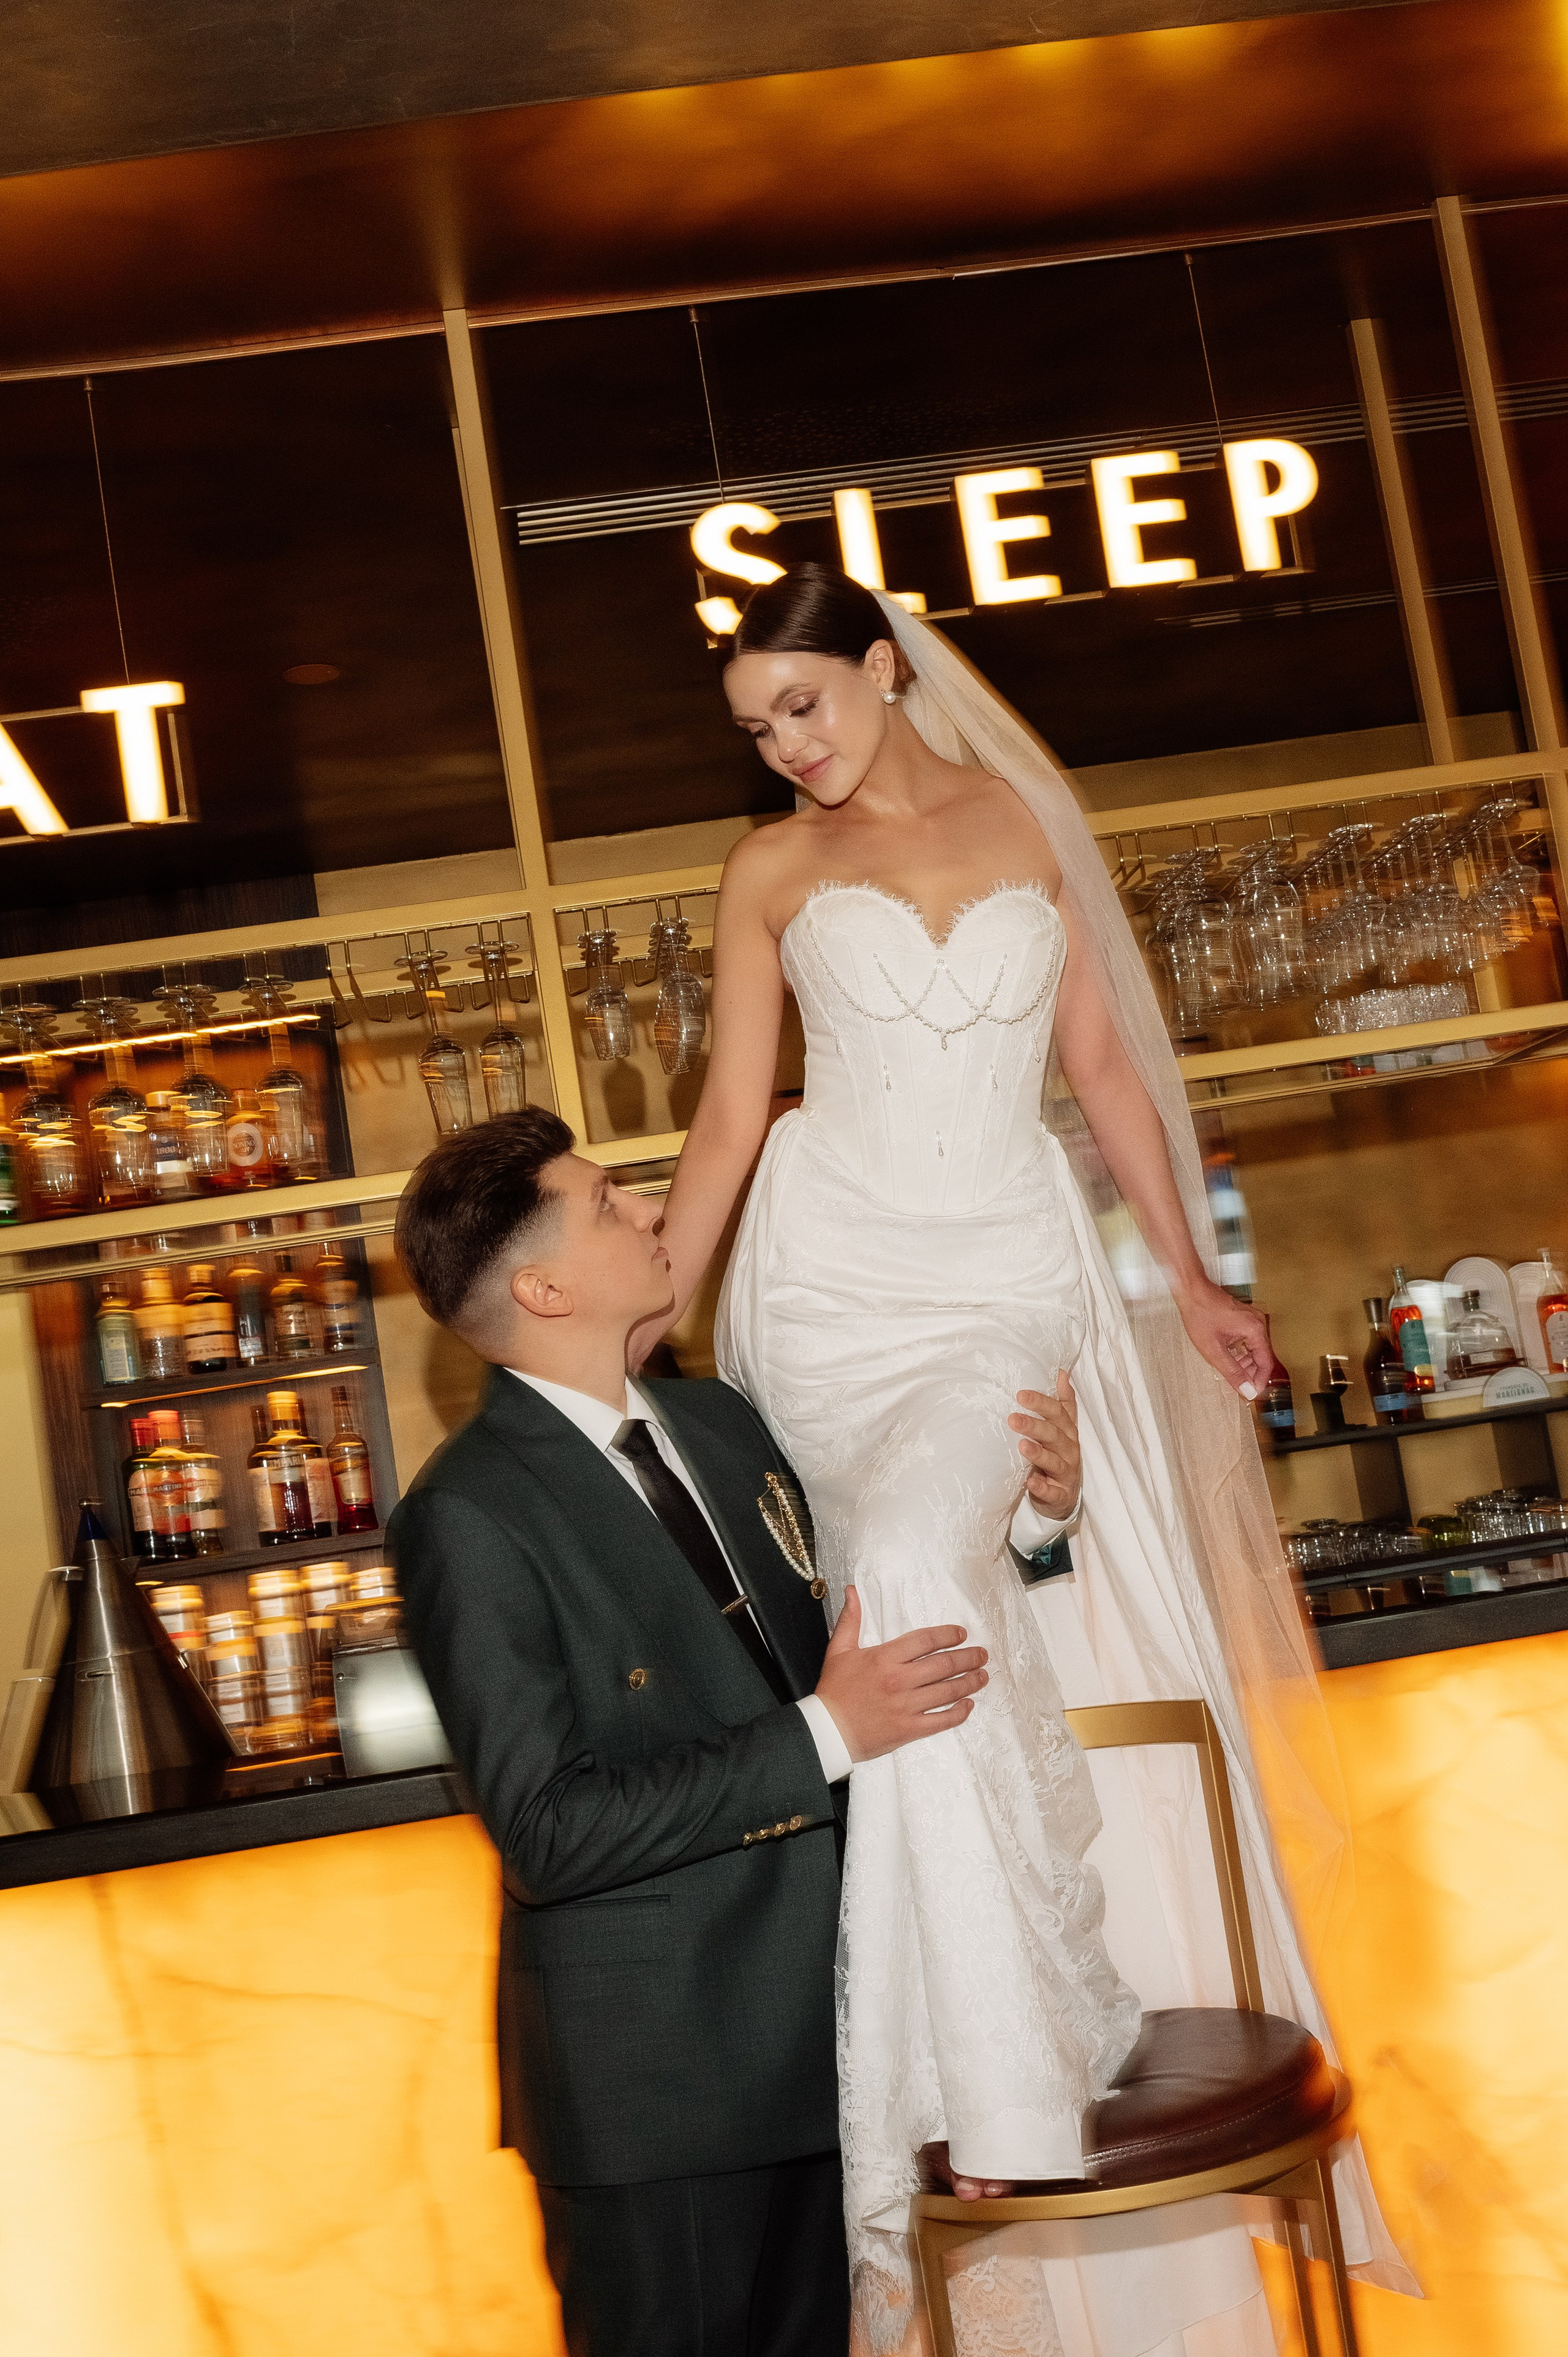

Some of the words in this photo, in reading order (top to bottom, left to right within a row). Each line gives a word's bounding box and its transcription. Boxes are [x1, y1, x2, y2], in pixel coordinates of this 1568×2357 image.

[690, 438, 1319, 635] SLEEP
[156, 1146, 176, 1155] 1800
[153, 1483, 182, 1492] MARTINI
